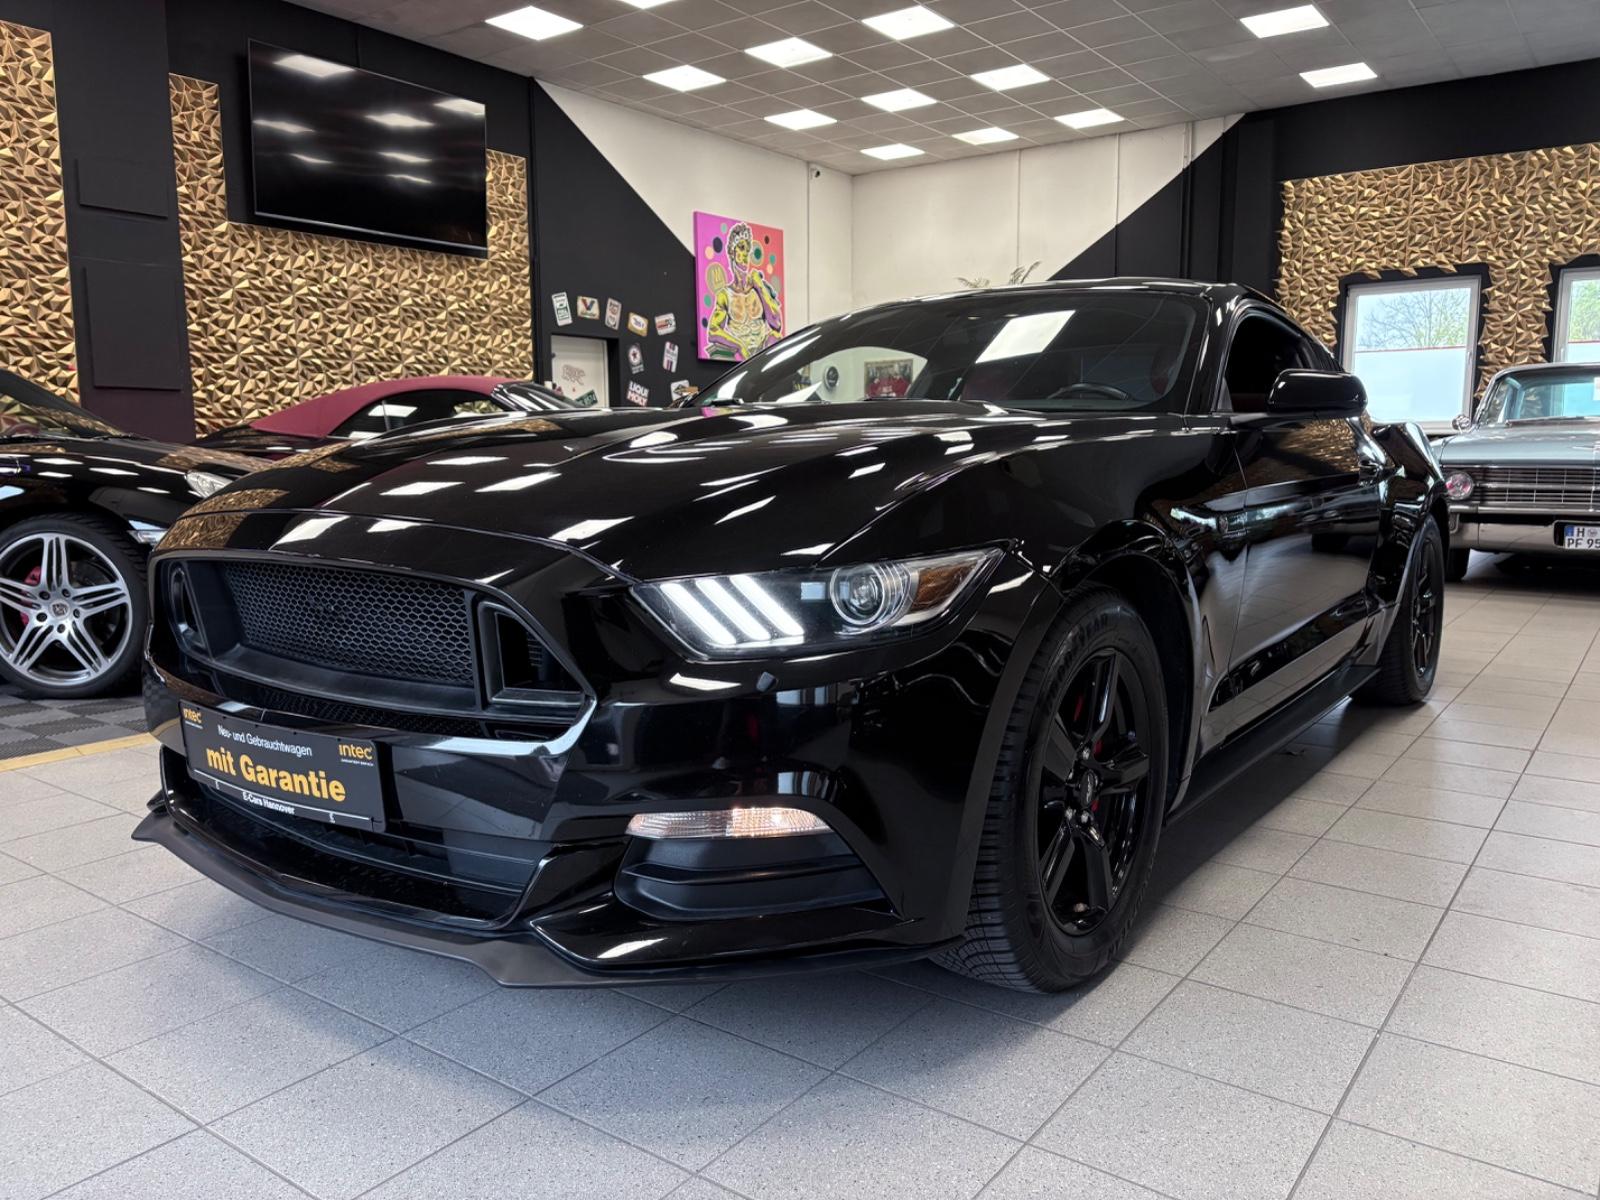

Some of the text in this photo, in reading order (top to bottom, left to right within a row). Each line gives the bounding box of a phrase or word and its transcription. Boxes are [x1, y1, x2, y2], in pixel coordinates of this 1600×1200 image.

[627, 390, 648, 406] MOLY
[1577, 527, 1585, 537] H
[1567, 538, 1583, 548] PF
[183, 708, 202, 724] intec
[217, 724, 232, 739] Neu-
[232, 732, 246, 743] und
[246, 734, 313, 758] Gebrauchtwagen
[338, 743, 373, 760] intec
[206, 746, 346, 802] mit Garantie
[263, 798, 295, 815] Hannover
